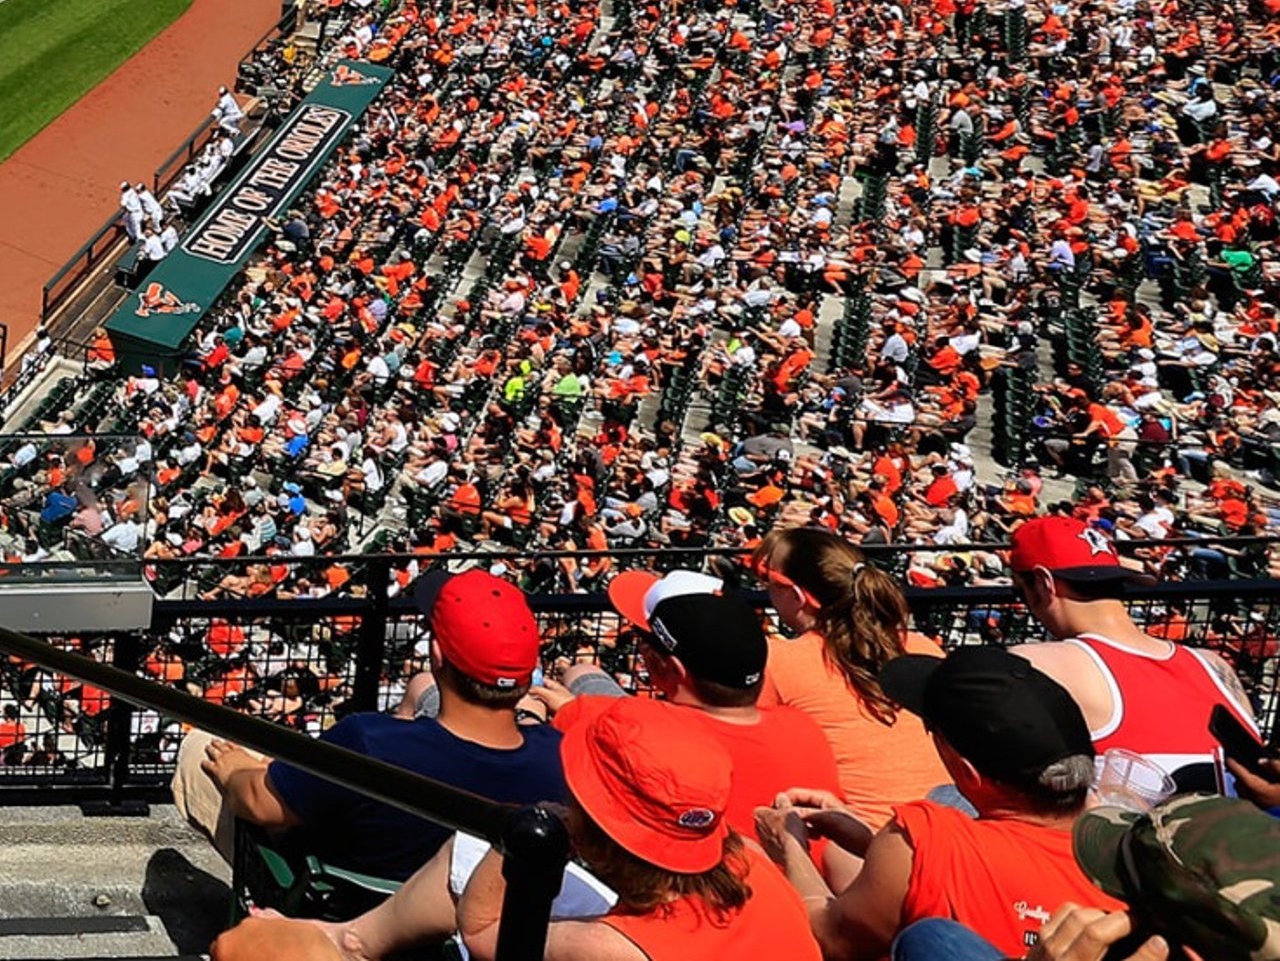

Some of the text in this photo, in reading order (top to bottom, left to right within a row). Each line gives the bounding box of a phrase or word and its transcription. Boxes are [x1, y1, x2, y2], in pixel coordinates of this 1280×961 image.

[191, 106, 342, 259] HOME OF THE ORIOLES
